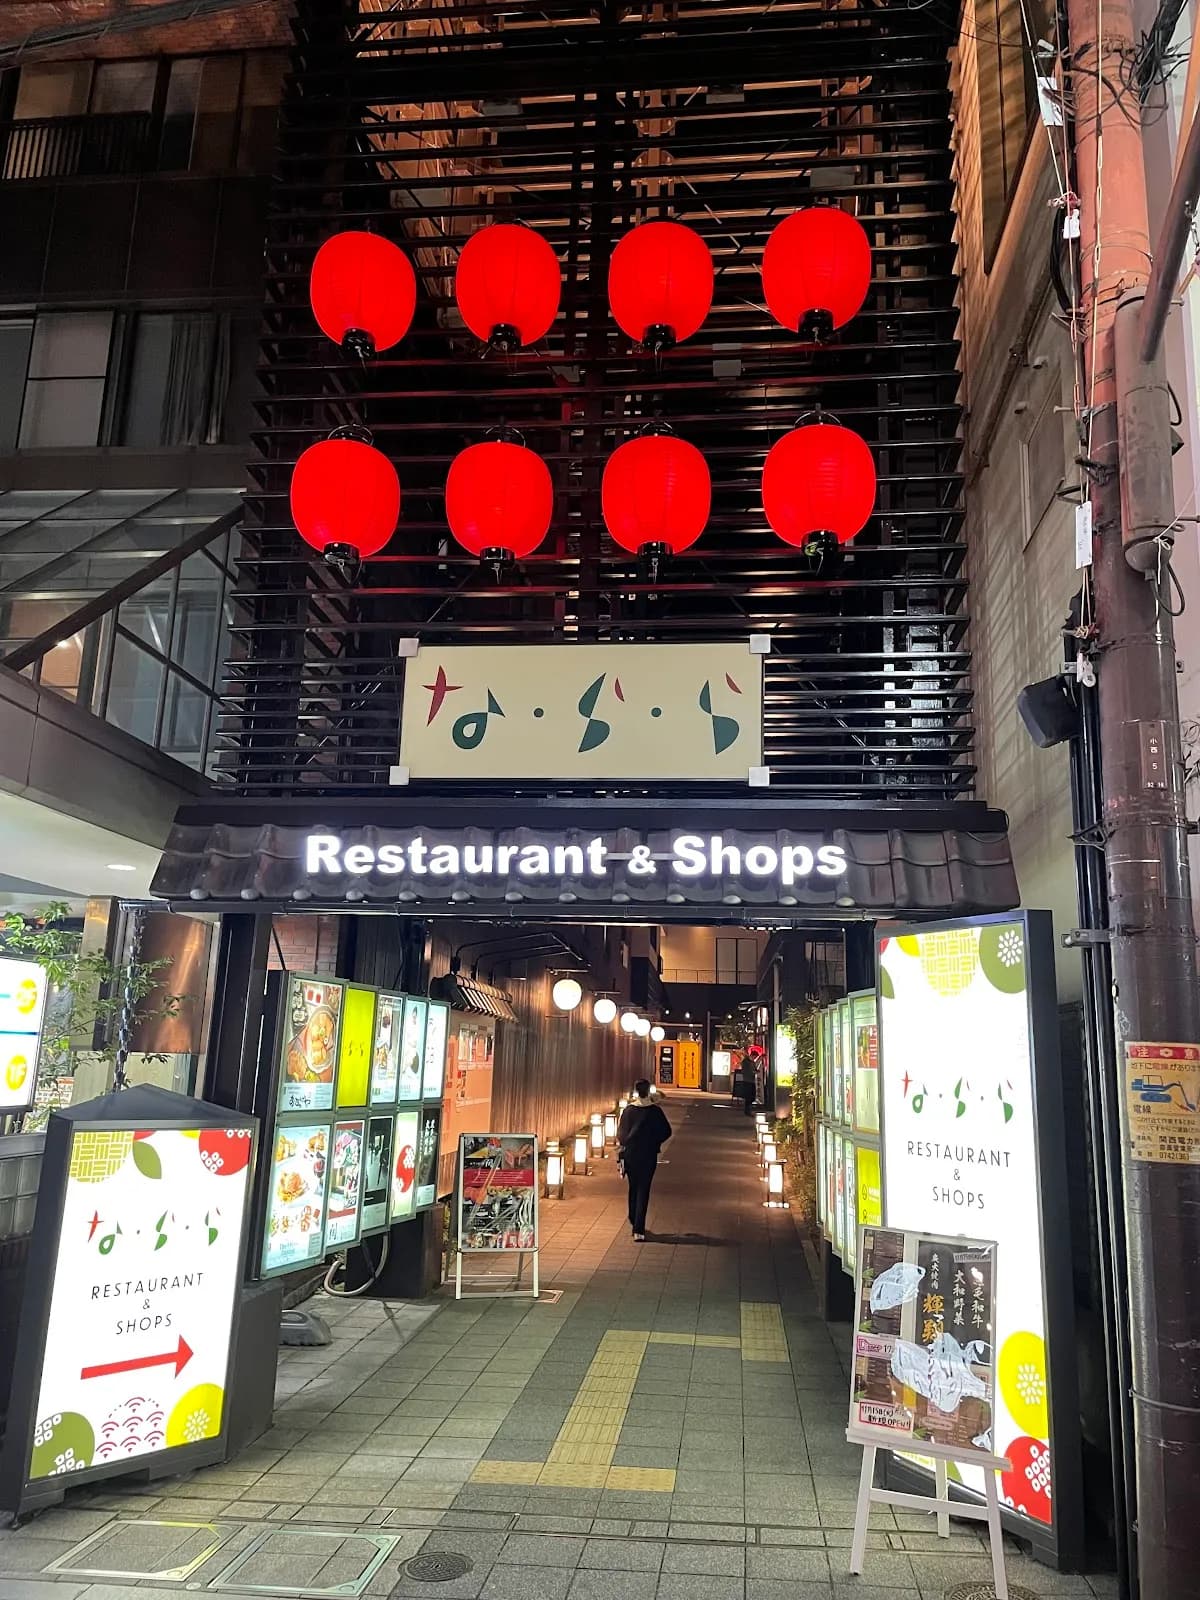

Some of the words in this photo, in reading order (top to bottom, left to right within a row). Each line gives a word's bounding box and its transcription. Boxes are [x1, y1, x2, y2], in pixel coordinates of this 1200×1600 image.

[306, 834, 608, 875] Restaurant
[628, 845, 657, 875] &
[672, 835, 848, 885] Shops
[907, 1140, 1011, 1168] RESTAURANT
[953, 1168, 961, 1181] &
[932, 1186, 985, 1210] SHOPS
[91, 1272, 204, 1300] RESTAURANT
[142, 1298, 151, 1310] &
[115, 1313, 172, 1335] SHOPS
